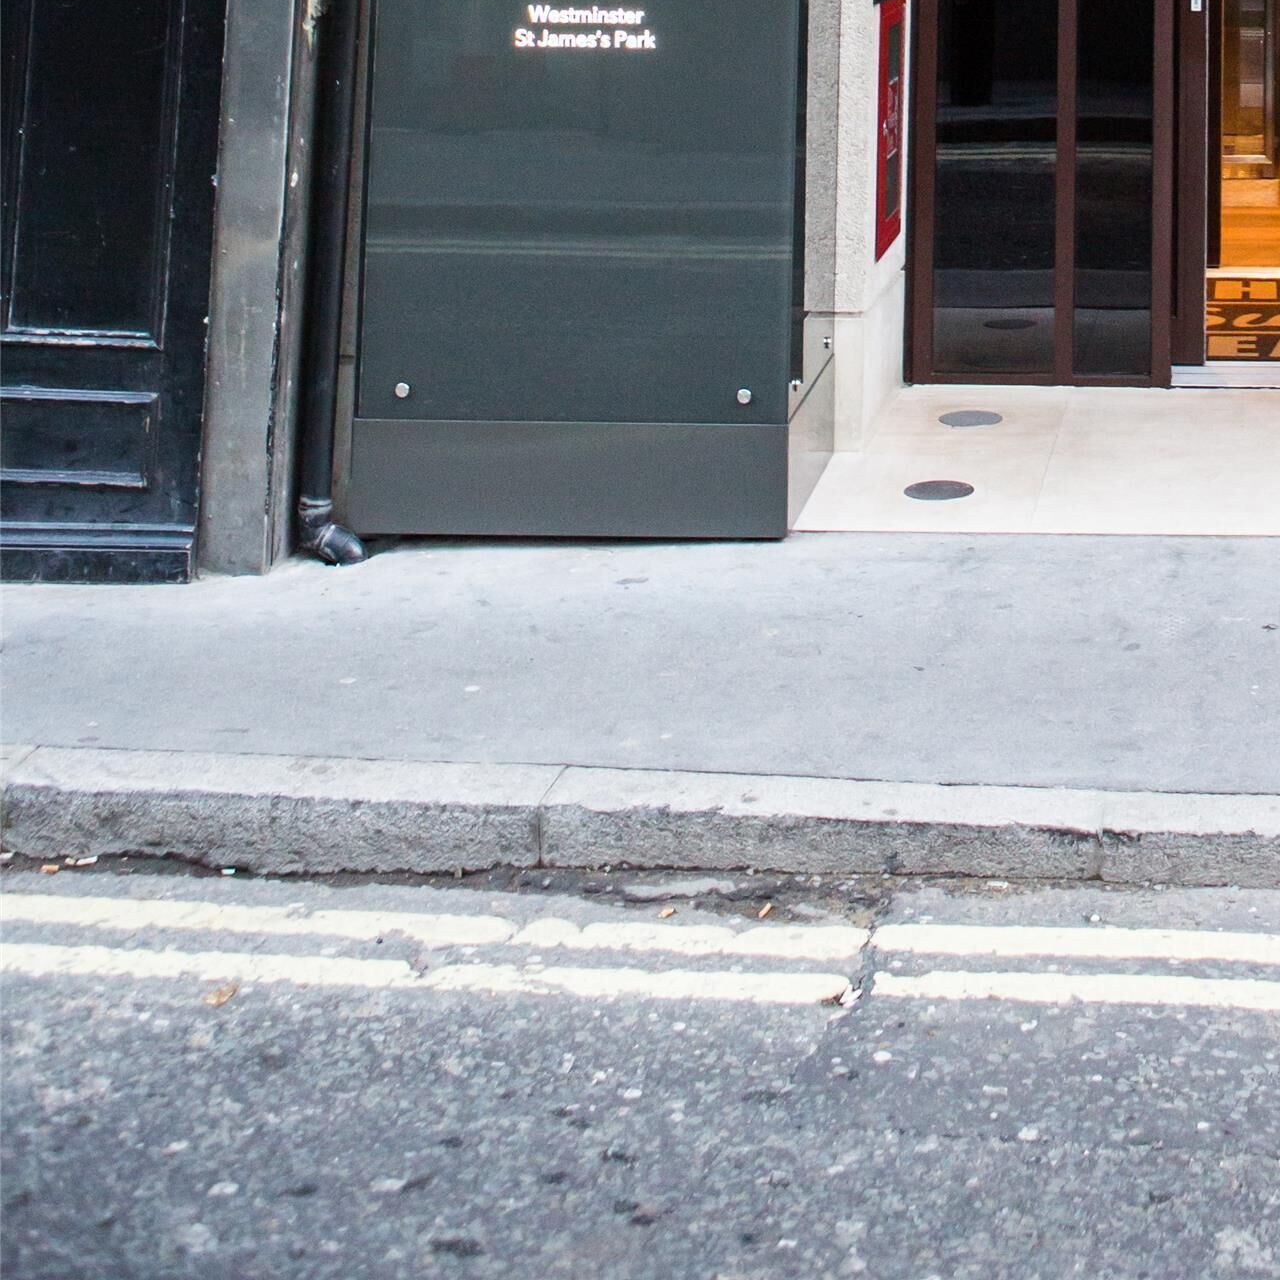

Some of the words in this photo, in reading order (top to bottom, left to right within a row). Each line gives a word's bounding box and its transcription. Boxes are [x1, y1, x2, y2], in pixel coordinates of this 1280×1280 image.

[528, 5, 645, 24] Westminster
[514, 28, 535, 48] St
[537, 29, 611, 49] James's
[614, 29, 656, 49] Park
